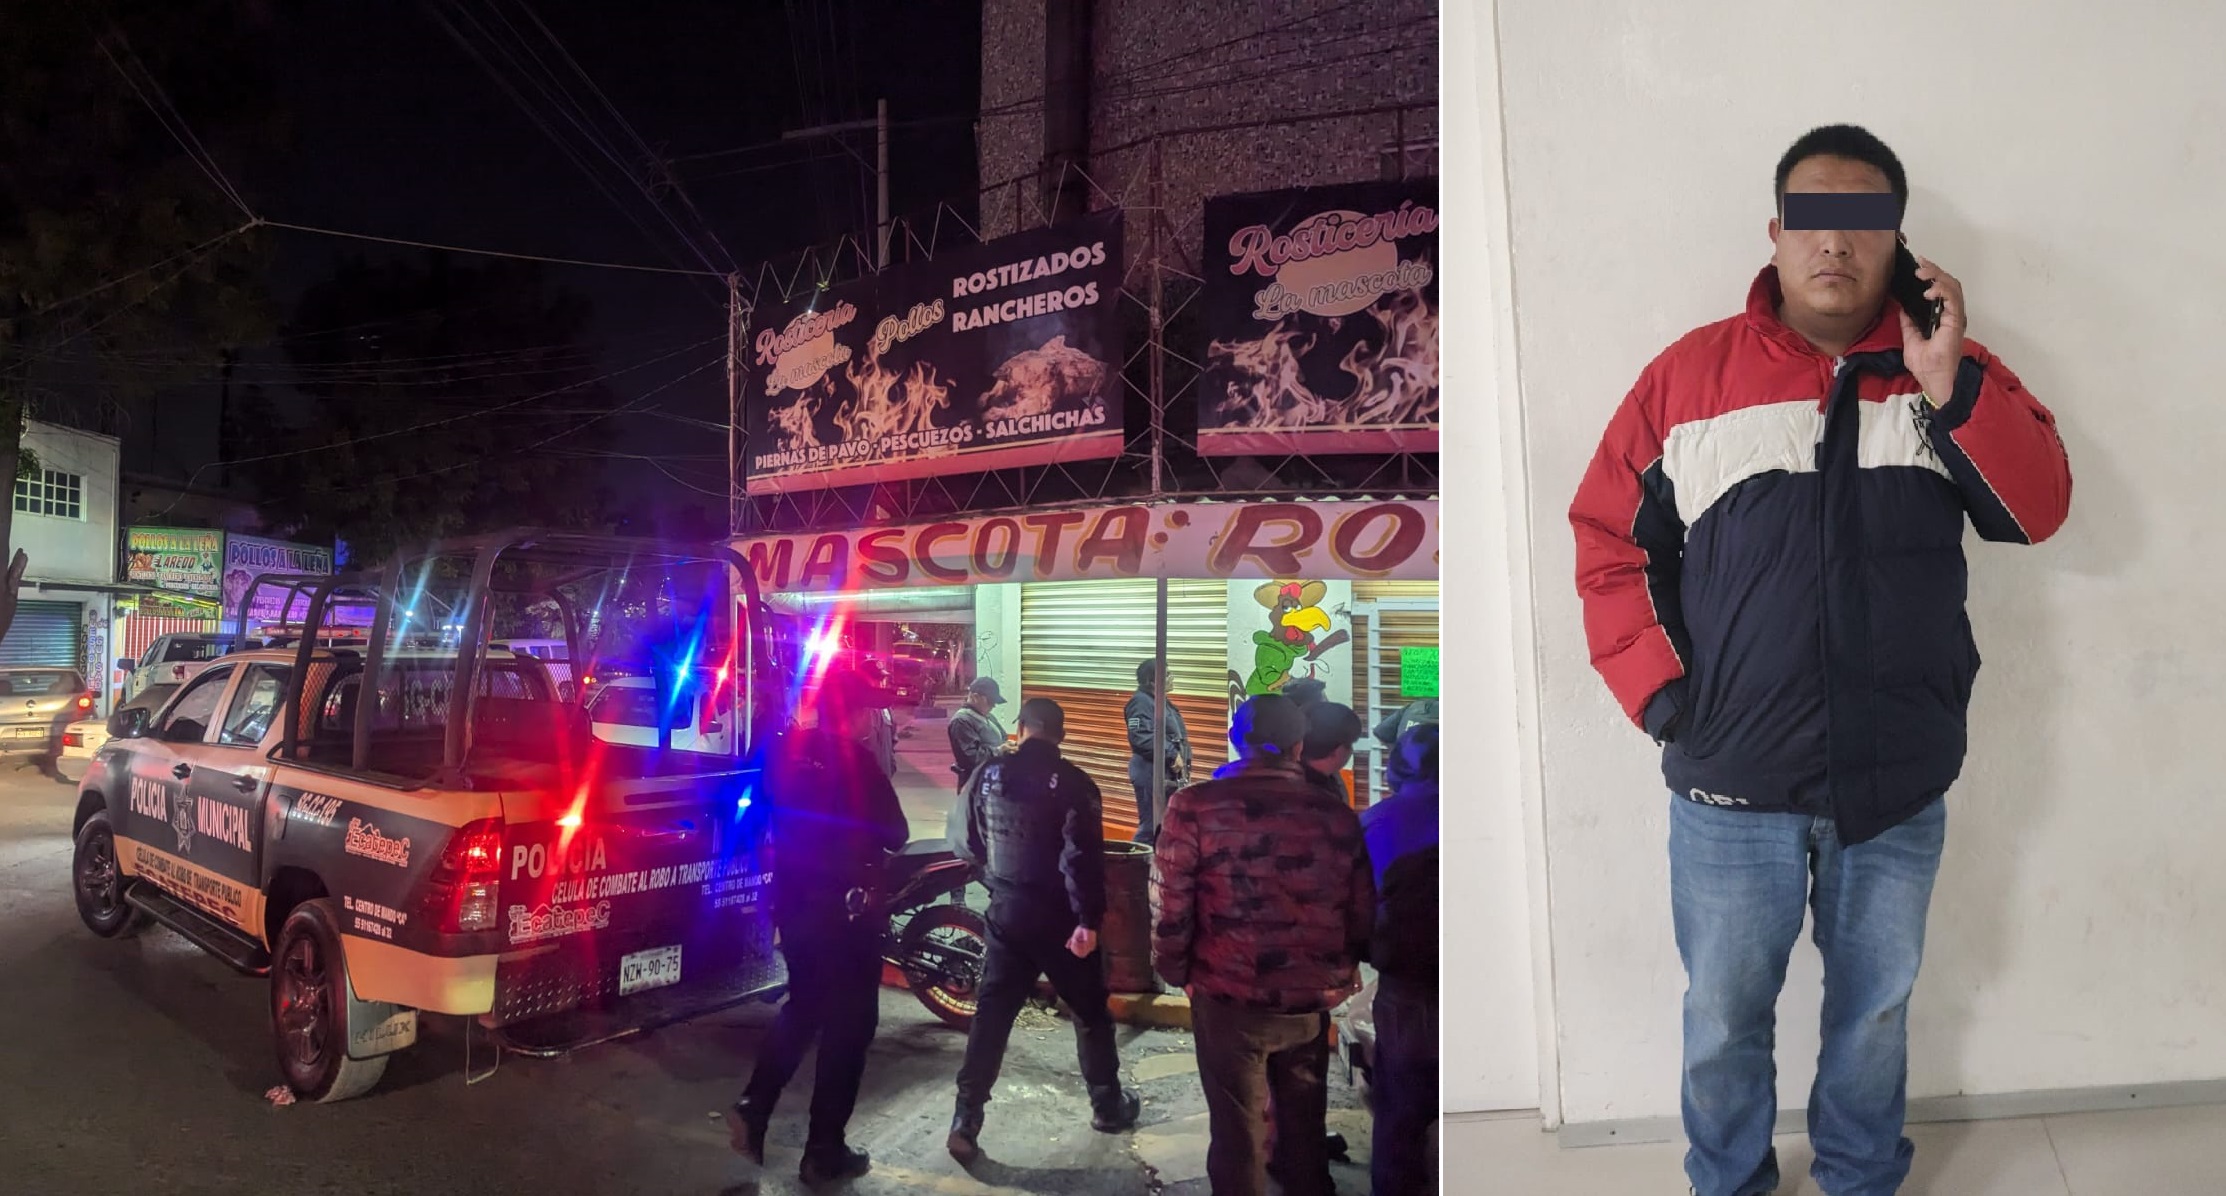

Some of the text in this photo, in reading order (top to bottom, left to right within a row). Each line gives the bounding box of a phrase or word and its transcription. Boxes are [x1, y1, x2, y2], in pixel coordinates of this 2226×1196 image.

[1229, 199, 1438, 276] Rosticería
[953, 241, 1105, 298] ROSTIZADOS
[1252, 259, 1433, 321] La mascota
[875, 298, 945, 354] Pollos
[952, 282, 1099, 333] RANCHEROS
[755, 300, 857, 366] Rosticería
[766, 371, 789, 397] La
[755, 406, 1105, 469] PIERNAS DE PAVO PESCUEZOS SALCHICHAS
[131, 532, 219, 552] POLLOS A LA LEÑA
[156, 555, 196, 569] LAREDO
[229, 541, 329, 573] POLLOS A LA LEÑA
[748, 502, 1438, 589] MASCOTA RO
[130, 777, 252, 852] POLICIA MUNICIPAL
[511, 838, 606, 880] POLICIA
[551, 878, 584, 904] CELULA
[586, 875, 598, 899] DE
[599, 871, 636, 898] COMBATE
[638, 870, 648, 892] AL
[650, 867, 670, 890] ROBO
[670, 865, 678, 888] A
[678, 858, 721, 885] TRANSPORTE
[193, 871, 221, 898] TRANSPORTE
[701, 884, 712, 896] TEL.
[736, 878, 743, 889] DE
[344, 895, 354, 910] TEL.
[355, 899, 374, 915] CENTRO
[374, 904, 381, 917] DE
[381, 906, 396, 923] MANDO
